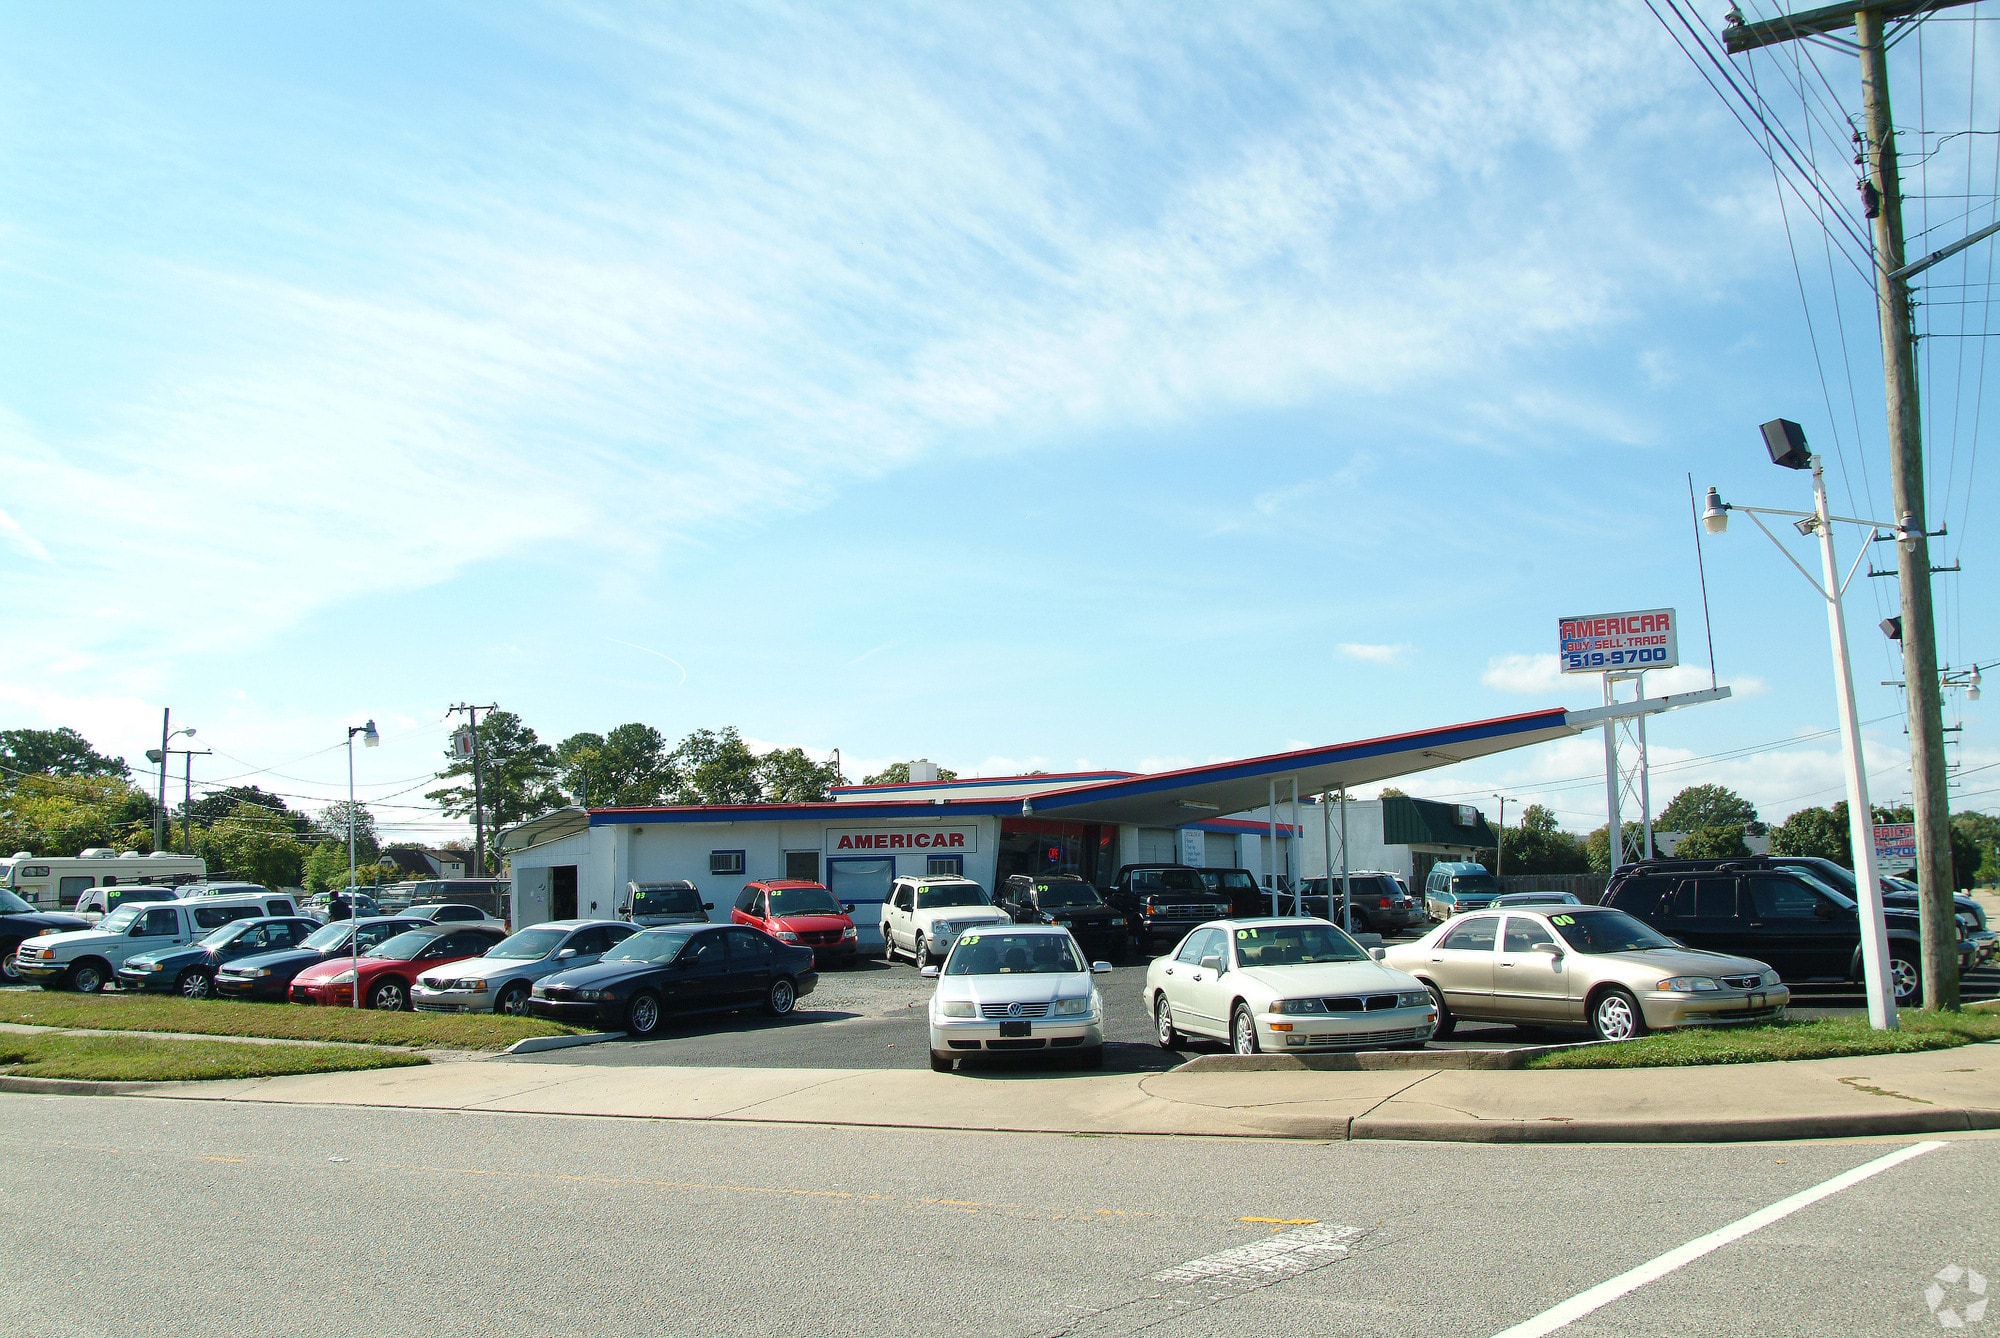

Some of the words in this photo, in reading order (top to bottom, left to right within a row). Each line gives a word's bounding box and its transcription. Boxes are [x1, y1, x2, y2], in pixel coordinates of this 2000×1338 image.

[1563, 613, 1670, 638] AMERICAR
[1569, 647, 1667, 667] 519-9700
[1873, 826, 1915, 838] ERICA
[837, 832, 964, 849] AMERICAR
[1551, 914, 1576, 926] 00
[1236, 928, 1258, 940] 01
